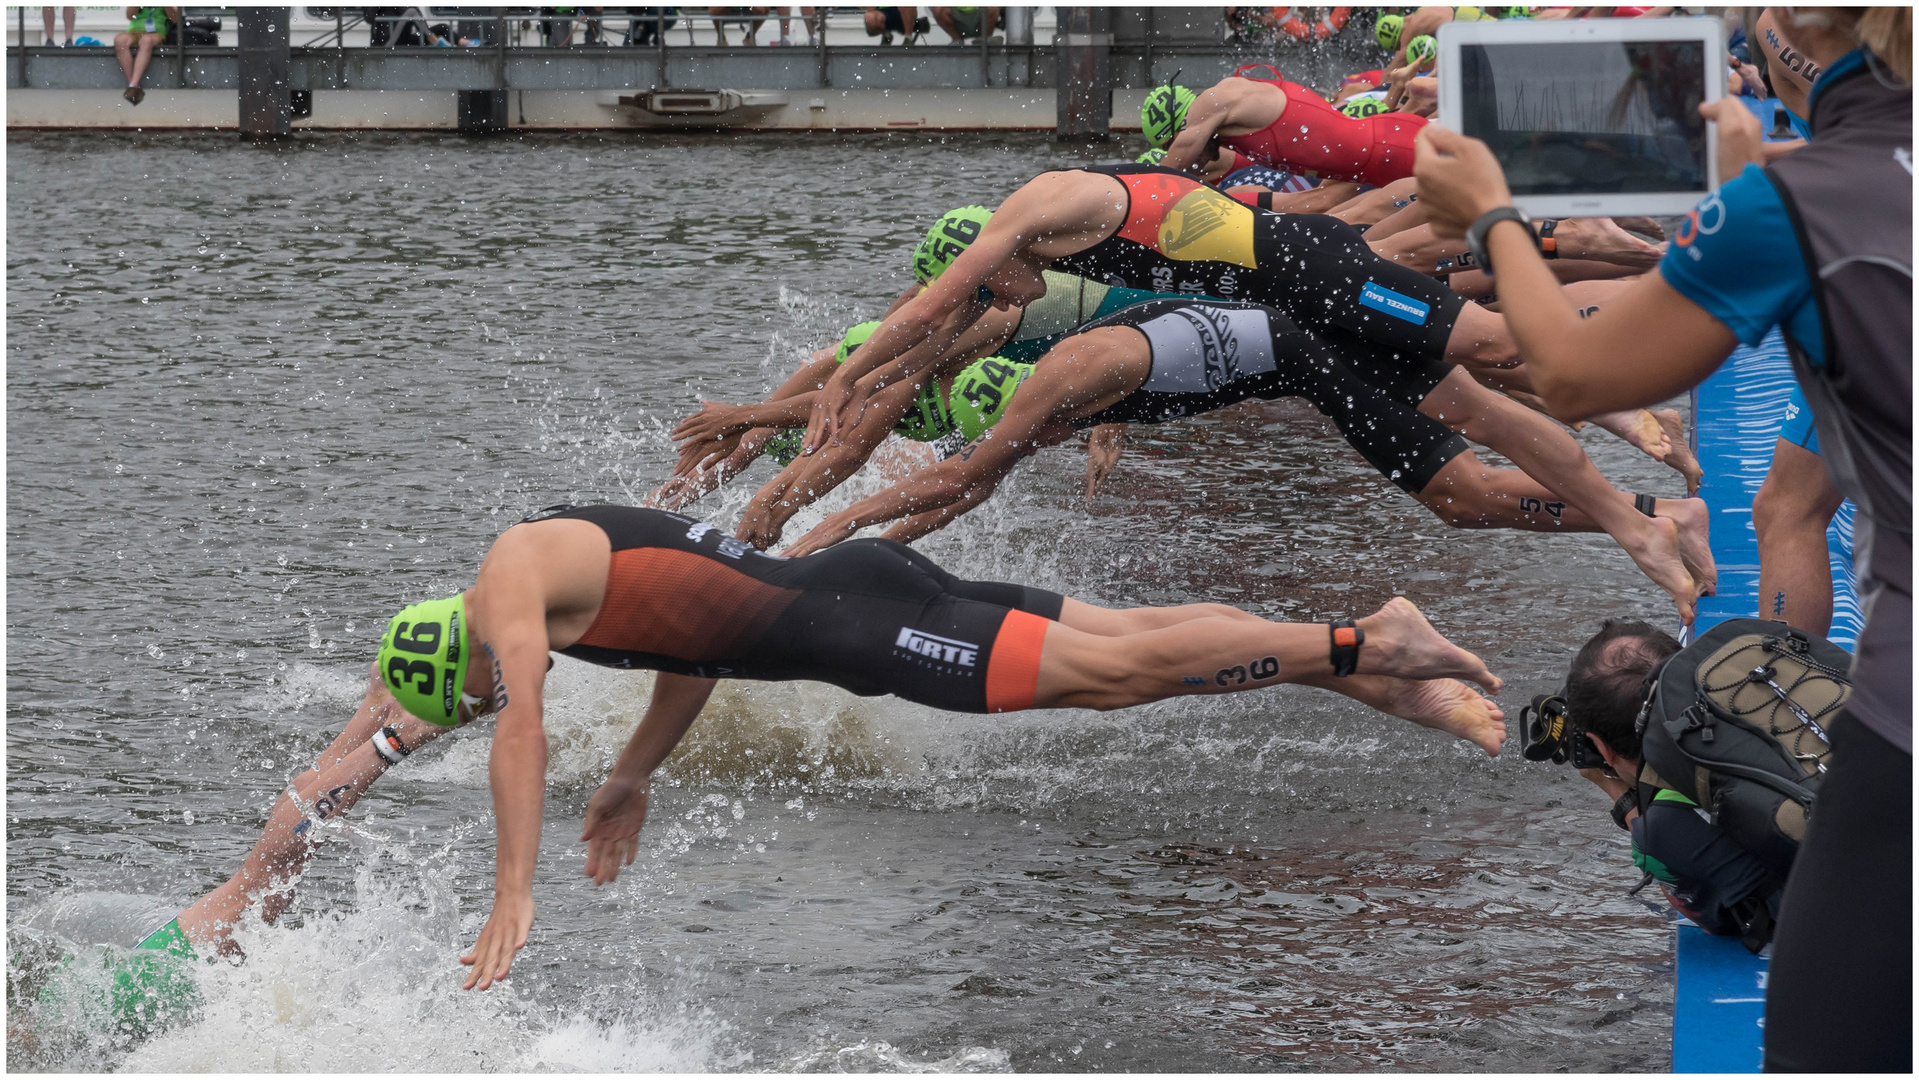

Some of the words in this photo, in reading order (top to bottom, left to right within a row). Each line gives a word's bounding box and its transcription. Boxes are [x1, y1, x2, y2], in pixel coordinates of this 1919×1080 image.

[1379, 21, 1396, 38] 12
[1148, 91, 1182, 127] 42
[933, 217, 981, 264] 56
[1365, 290, 1386, 303] BAU
[1386, 298, 1426, 318] BRUNZEL
[961, 360, 1017, 415] 54
[1519, 497, 1567, 518] 54
[388, 621, 442, 696] 36
[1214, 656, 1280, 687] 36
